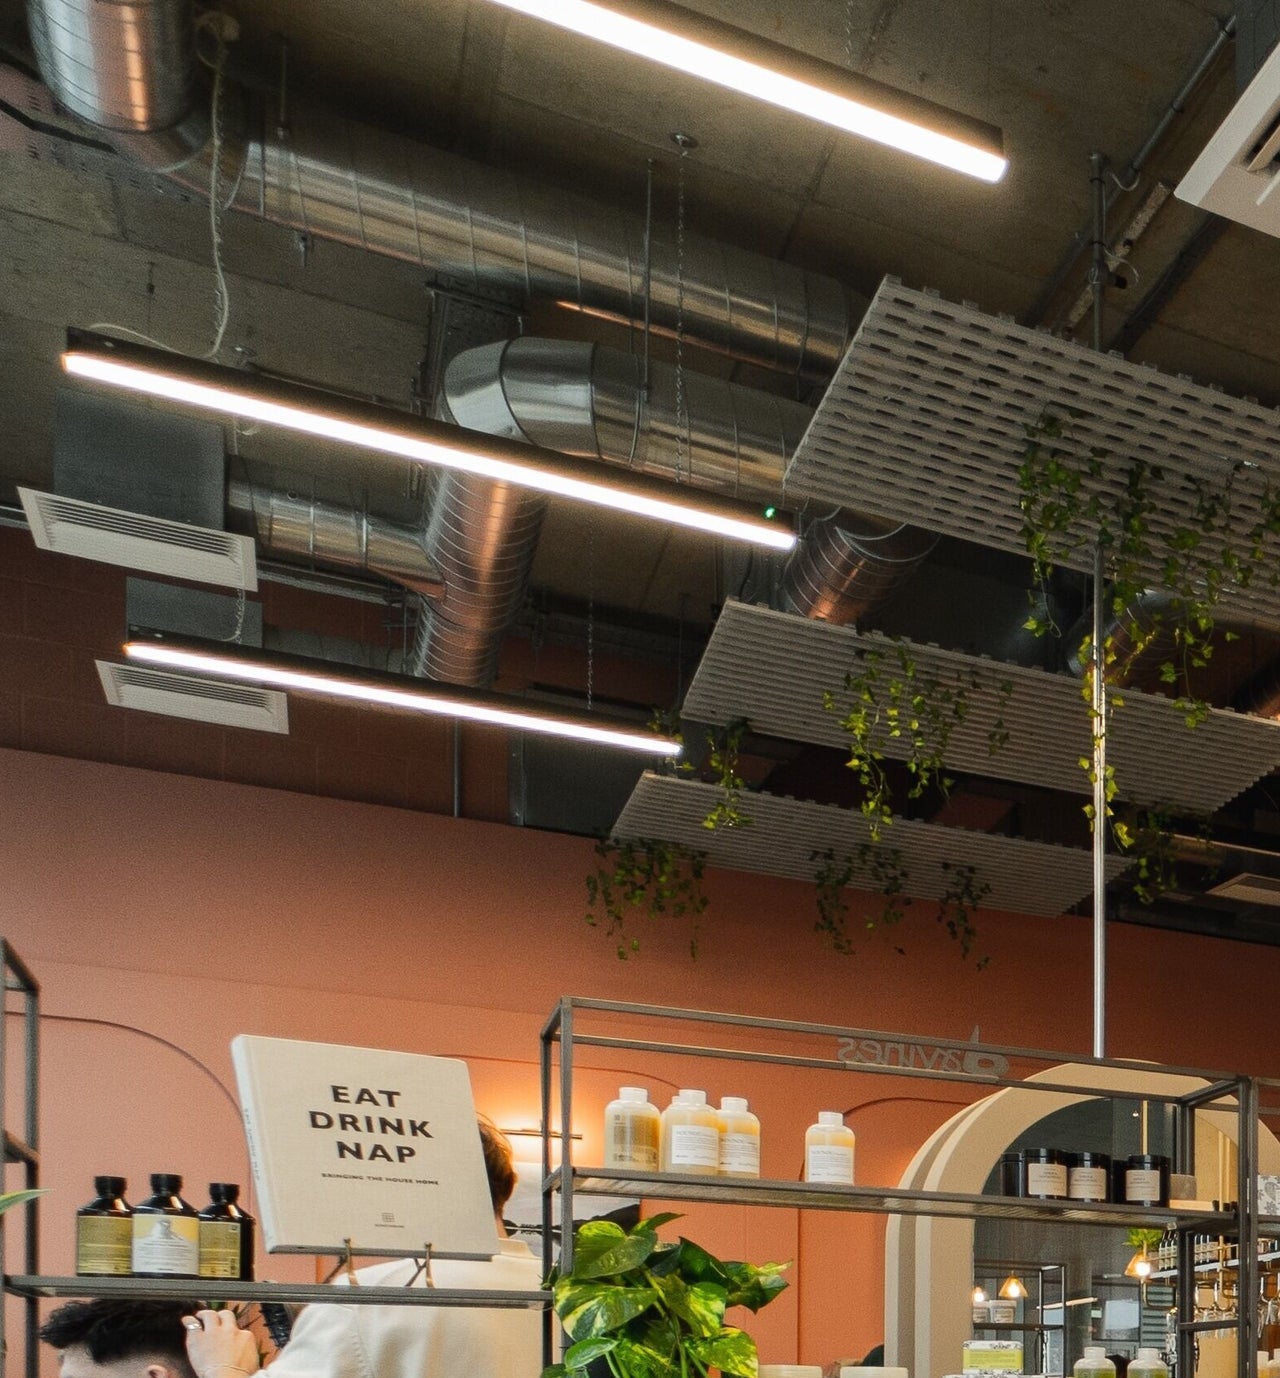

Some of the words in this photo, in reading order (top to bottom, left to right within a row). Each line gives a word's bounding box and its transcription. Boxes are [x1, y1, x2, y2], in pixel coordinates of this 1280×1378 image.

[330, 1085, 401, 1108] EAT
[308, 1110, 434, 1139] DRINK
[336, 1140, 416, 1164] NAP
